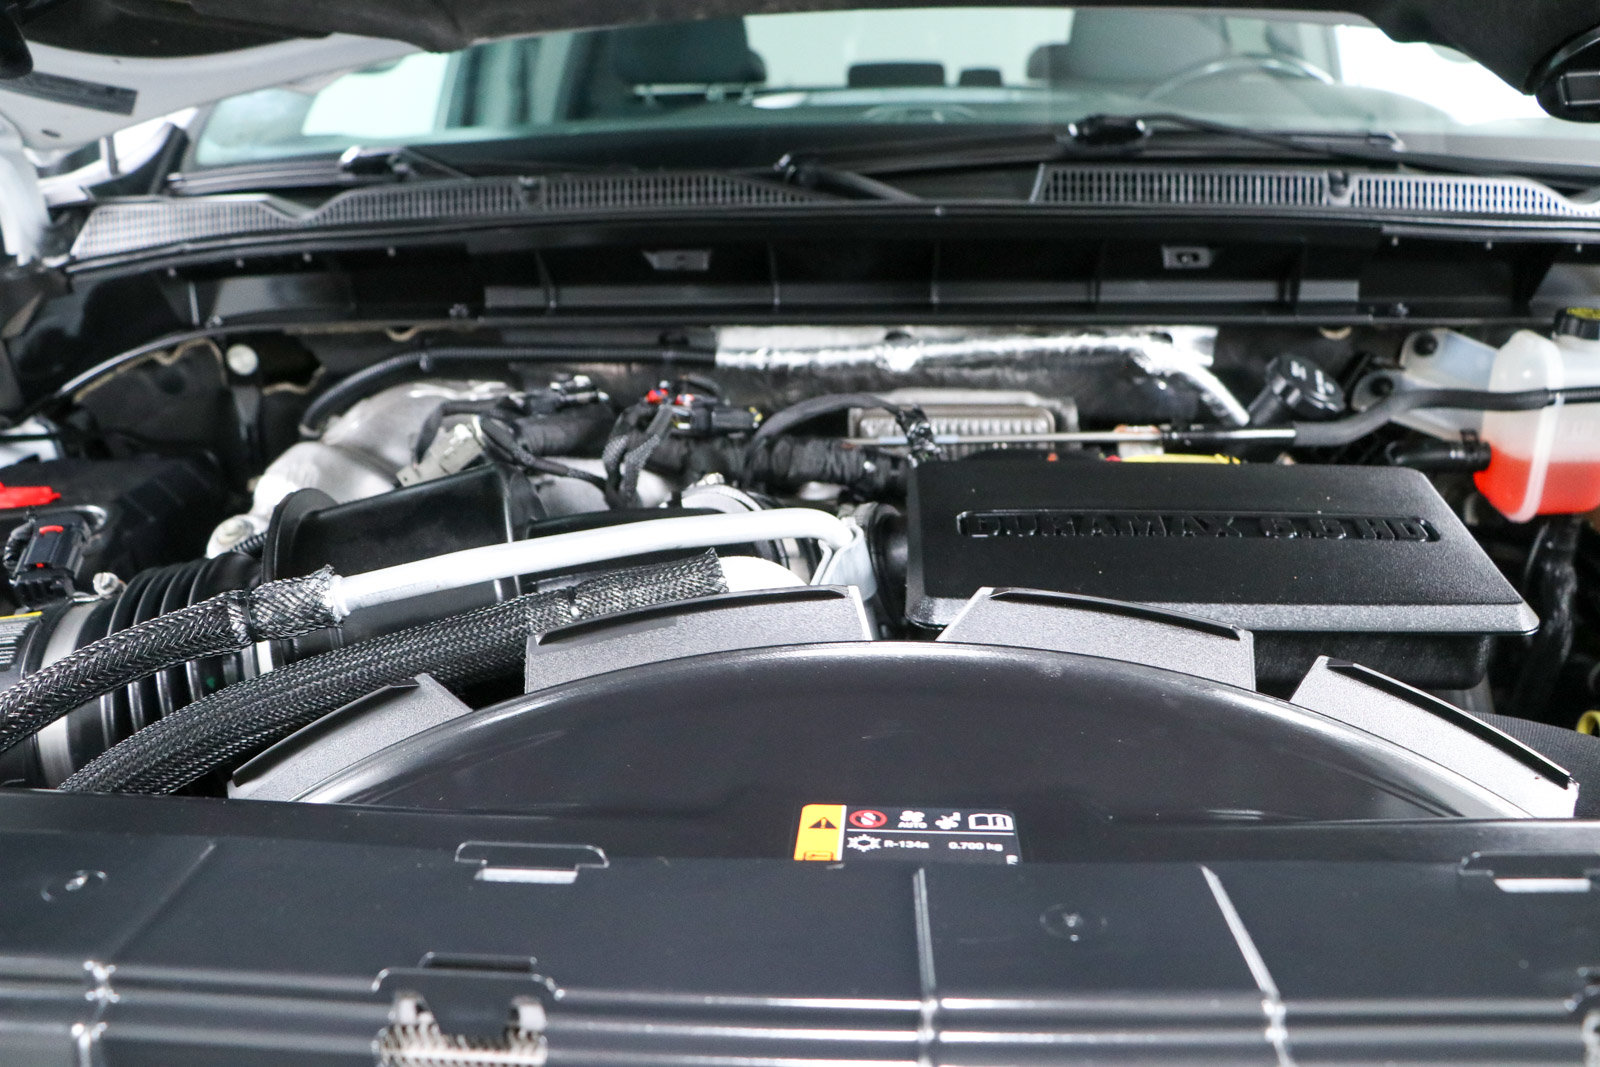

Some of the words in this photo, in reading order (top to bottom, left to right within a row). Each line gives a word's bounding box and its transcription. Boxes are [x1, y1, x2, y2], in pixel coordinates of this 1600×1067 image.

[969, 514, 1243, 538] DURAMAX
[898, 821, 928, 829] AUTO
[884, 839, 930, 849] R-134a
[986, 842, 1004, 852] kg
